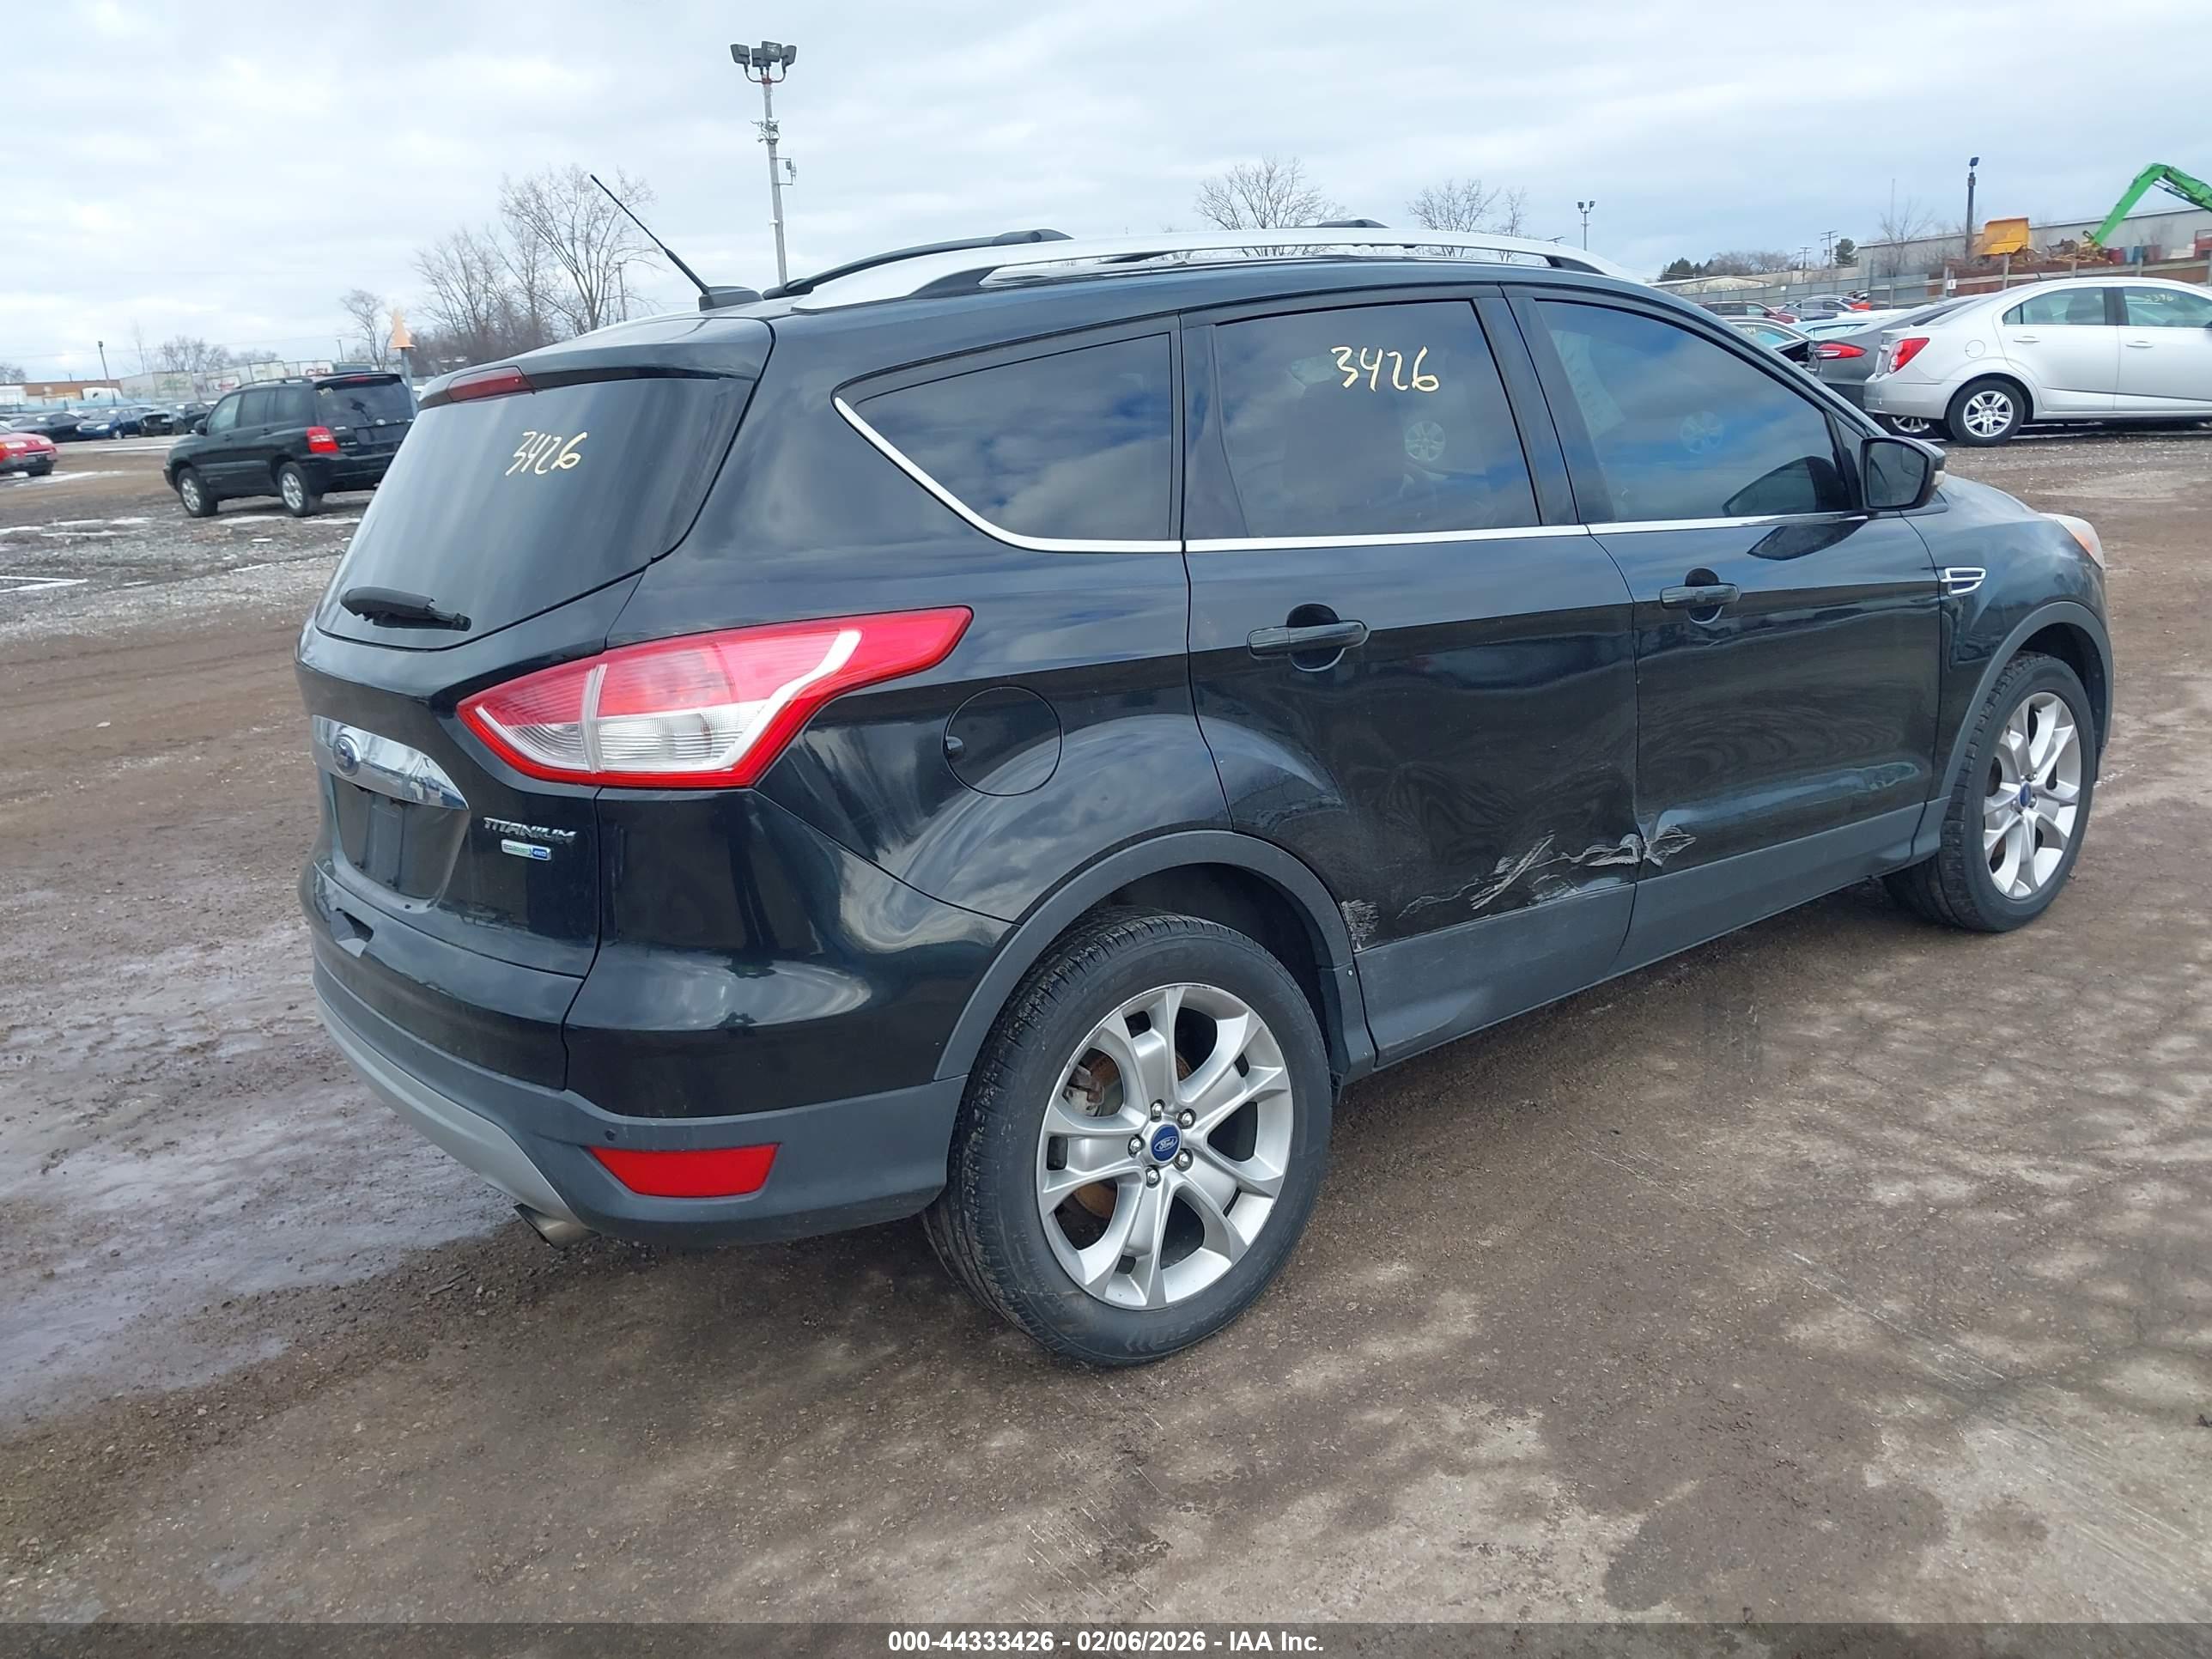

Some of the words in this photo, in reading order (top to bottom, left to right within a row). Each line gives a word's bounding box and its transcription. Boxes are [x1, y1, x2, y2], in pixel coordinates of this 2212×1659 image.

[1331, 346, 1440, 392] 3426
[505, 431, 588, 476] 3426
[483, 817, 576, 844] TITANIUM
[1157, 1137, 1176, 1151] Ford
